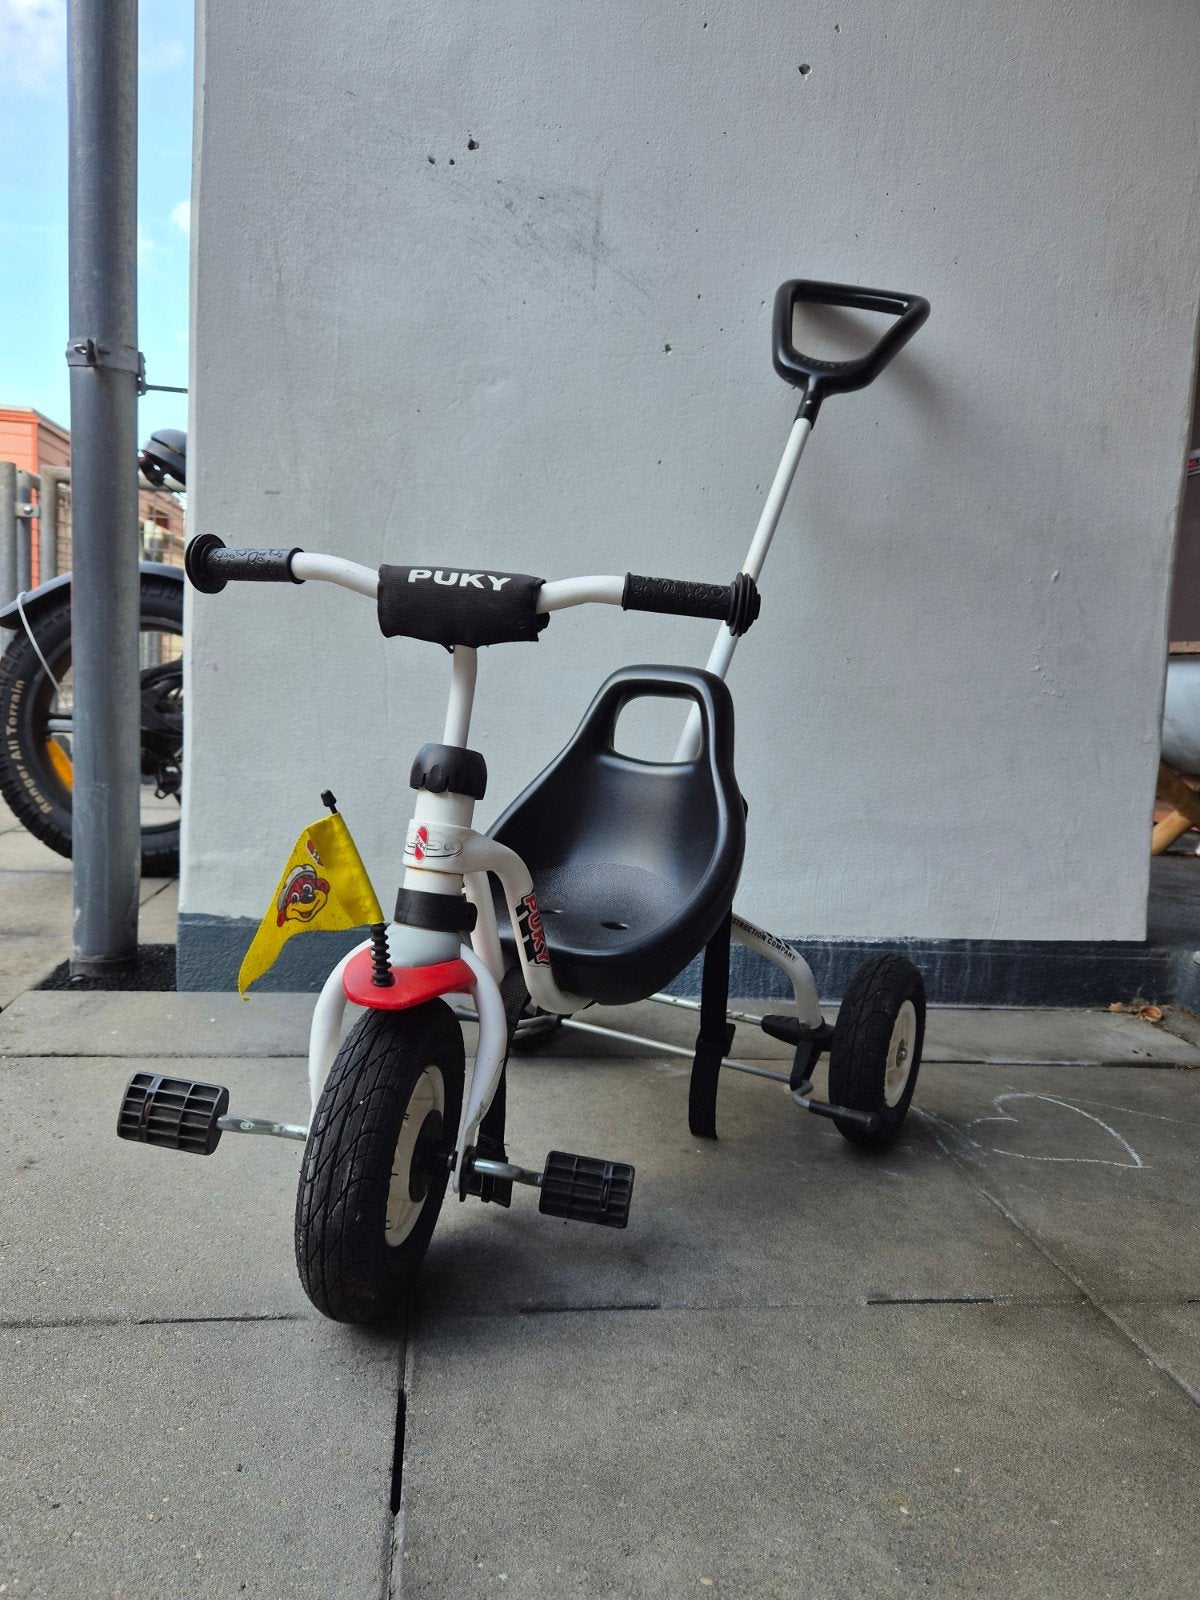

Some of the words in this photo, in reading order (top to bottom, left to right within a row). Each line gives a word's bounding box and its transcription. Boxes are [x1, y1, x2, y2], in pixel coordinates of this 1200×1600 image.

[407, 569, 512, 591] PUKY
[5, 679, 25, 735] Terrain
[8, 740, 23, 760] All
[16, 764, 52, 814] Ranger
[523, 895, 550, 962] PUKY
[767, 938, 796, 961] COMPANY
